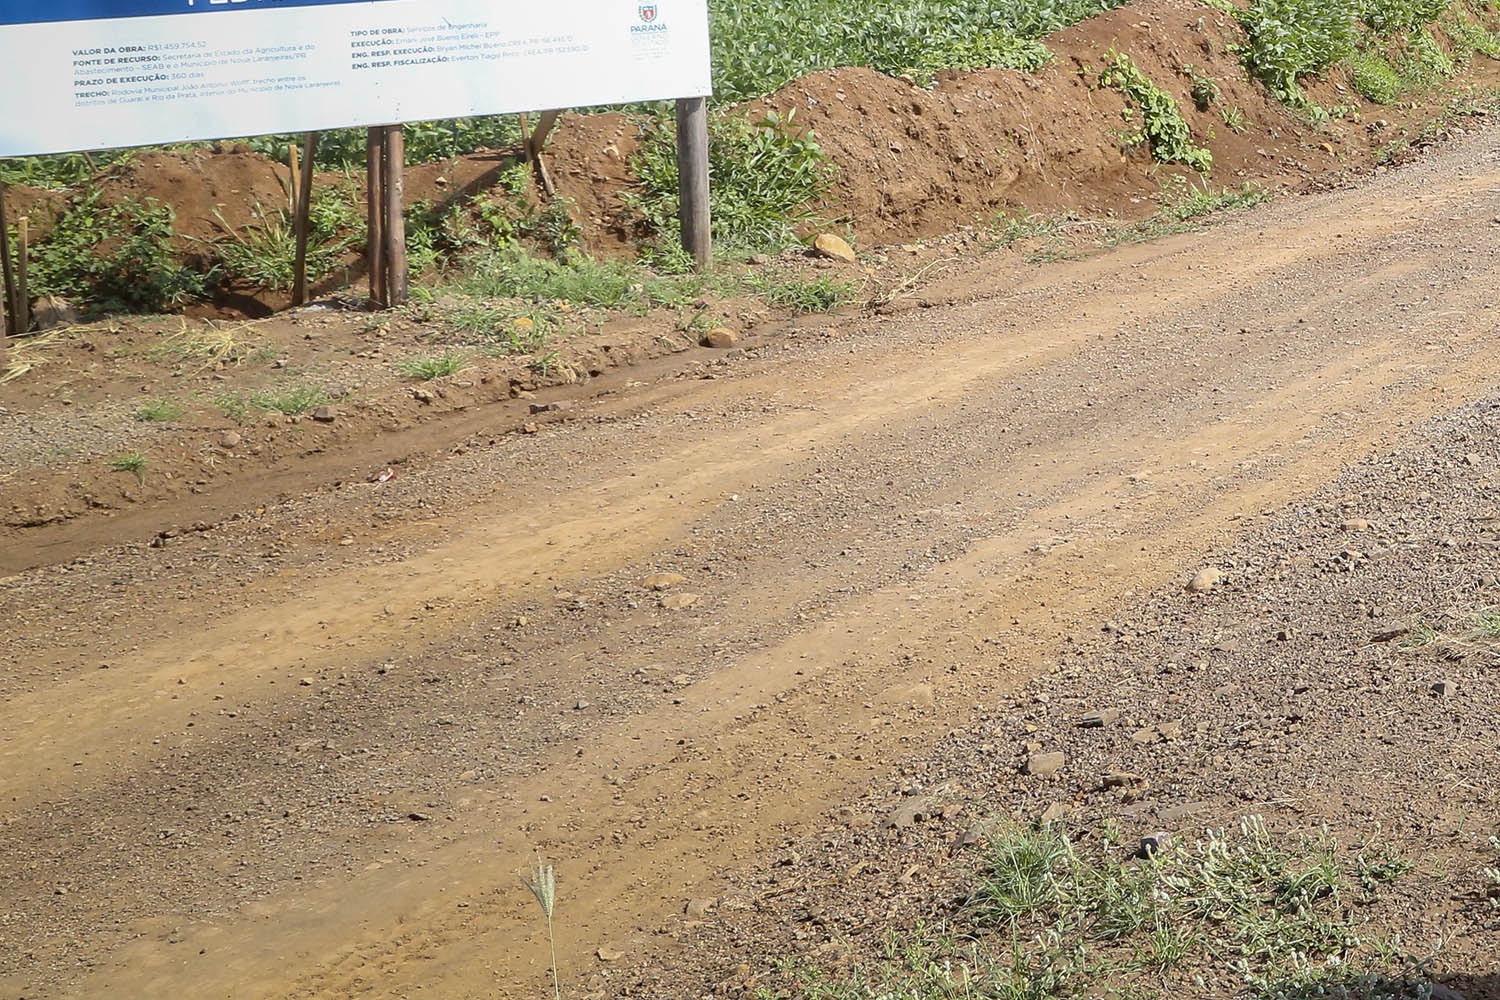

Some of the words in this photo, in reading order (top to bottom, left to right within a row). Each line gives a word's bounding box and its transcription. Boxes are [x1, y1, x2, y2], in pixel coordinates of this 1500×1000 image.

[351, 39, 394, 48] EXECUÇÃO:
[72, 48, 101, 56] VALOR
[118, 45, 146, 53] OBRA:
[393, 46, 435, 56] EXECUÇÃO:
[73, 58, 102, 67] FONTE
[118, 55, 160, 64] RECURSO:
[393, 56, 449, 66] FISCALIZAÇÃO:
[74, 79, 104, 87] PRAZO
[120, 73, 169, 83] EXECUÇÃO:
[75, 91, 110, 99] TRECHO:
